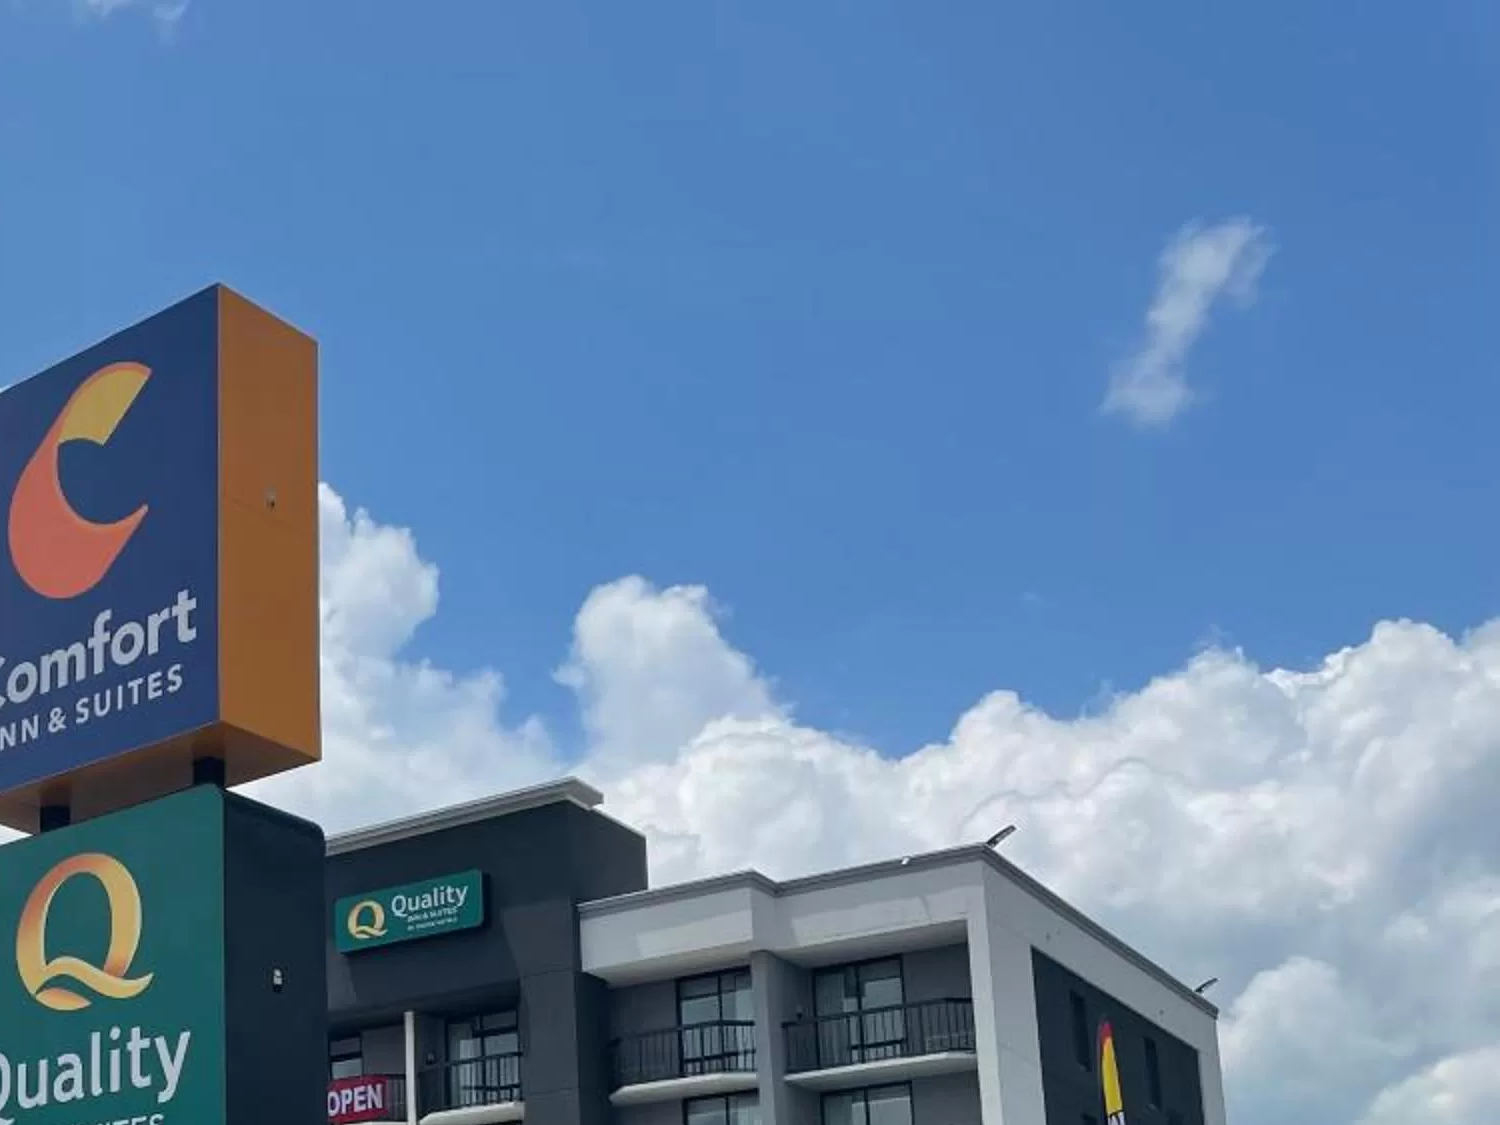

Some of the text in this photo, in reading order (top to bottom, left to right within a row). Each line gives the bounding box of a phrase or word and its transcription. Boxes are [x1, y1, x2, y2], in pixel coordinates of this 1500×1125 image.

[48, 707, 67, 733] &
[75, 663, 184, 724] SUITES
[391, 885, 468, 917] Quality
[15, 852, 155, 1011] Q
[328, 1082, 384, 1117] OPEN
